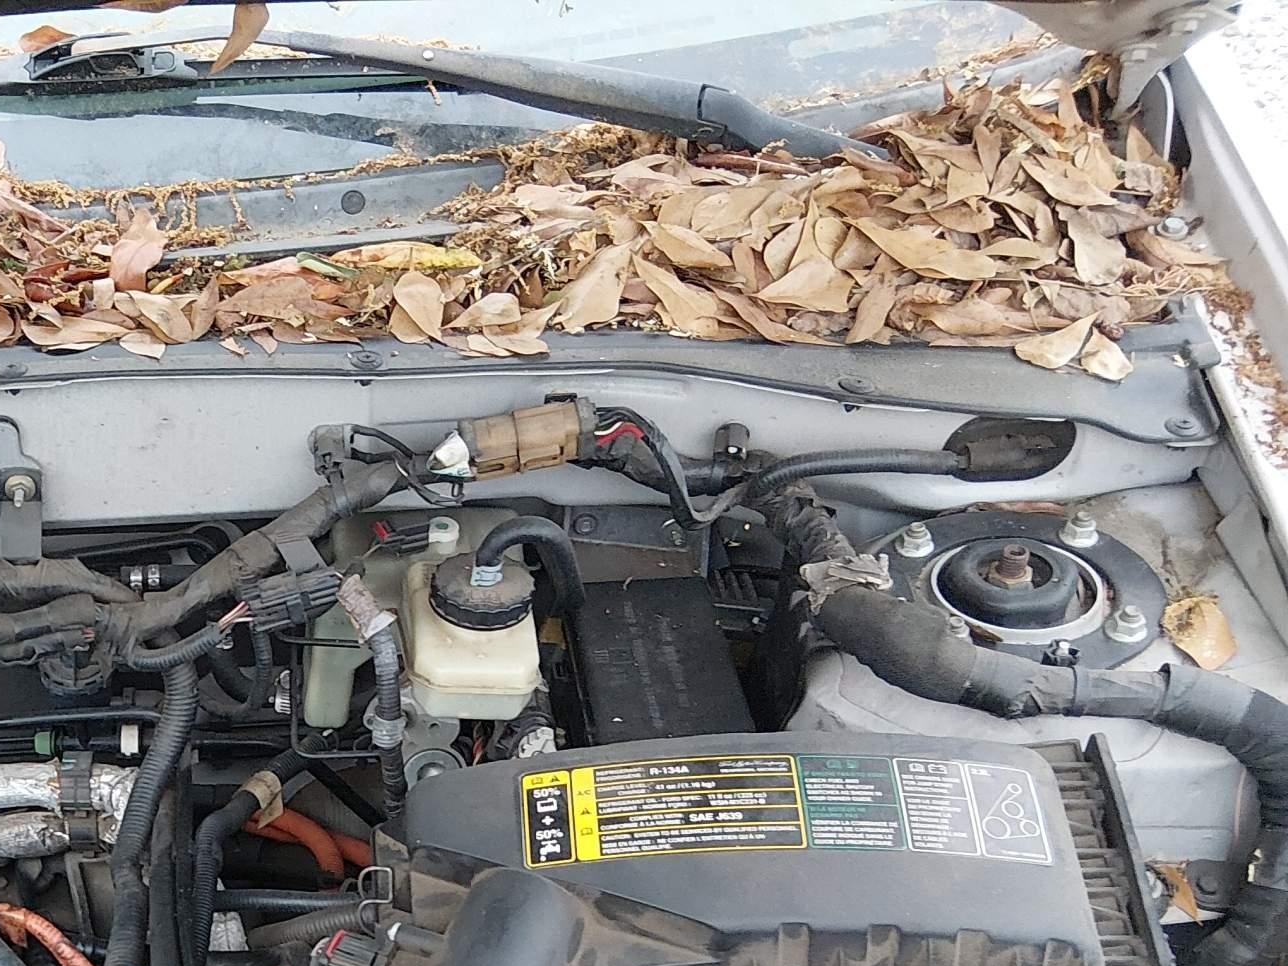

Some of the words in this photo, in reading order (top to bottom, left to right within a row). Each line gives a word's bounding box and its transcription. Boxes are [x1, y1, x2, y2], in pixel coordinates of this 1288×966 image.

[649, 765, 690, 776] R-134A
[532, 786, 561, 799] 50%
[689, 812, 714, 822] SAE
[715, 811, 743, 821] J639
[535, 828, 564, 841] 50%
